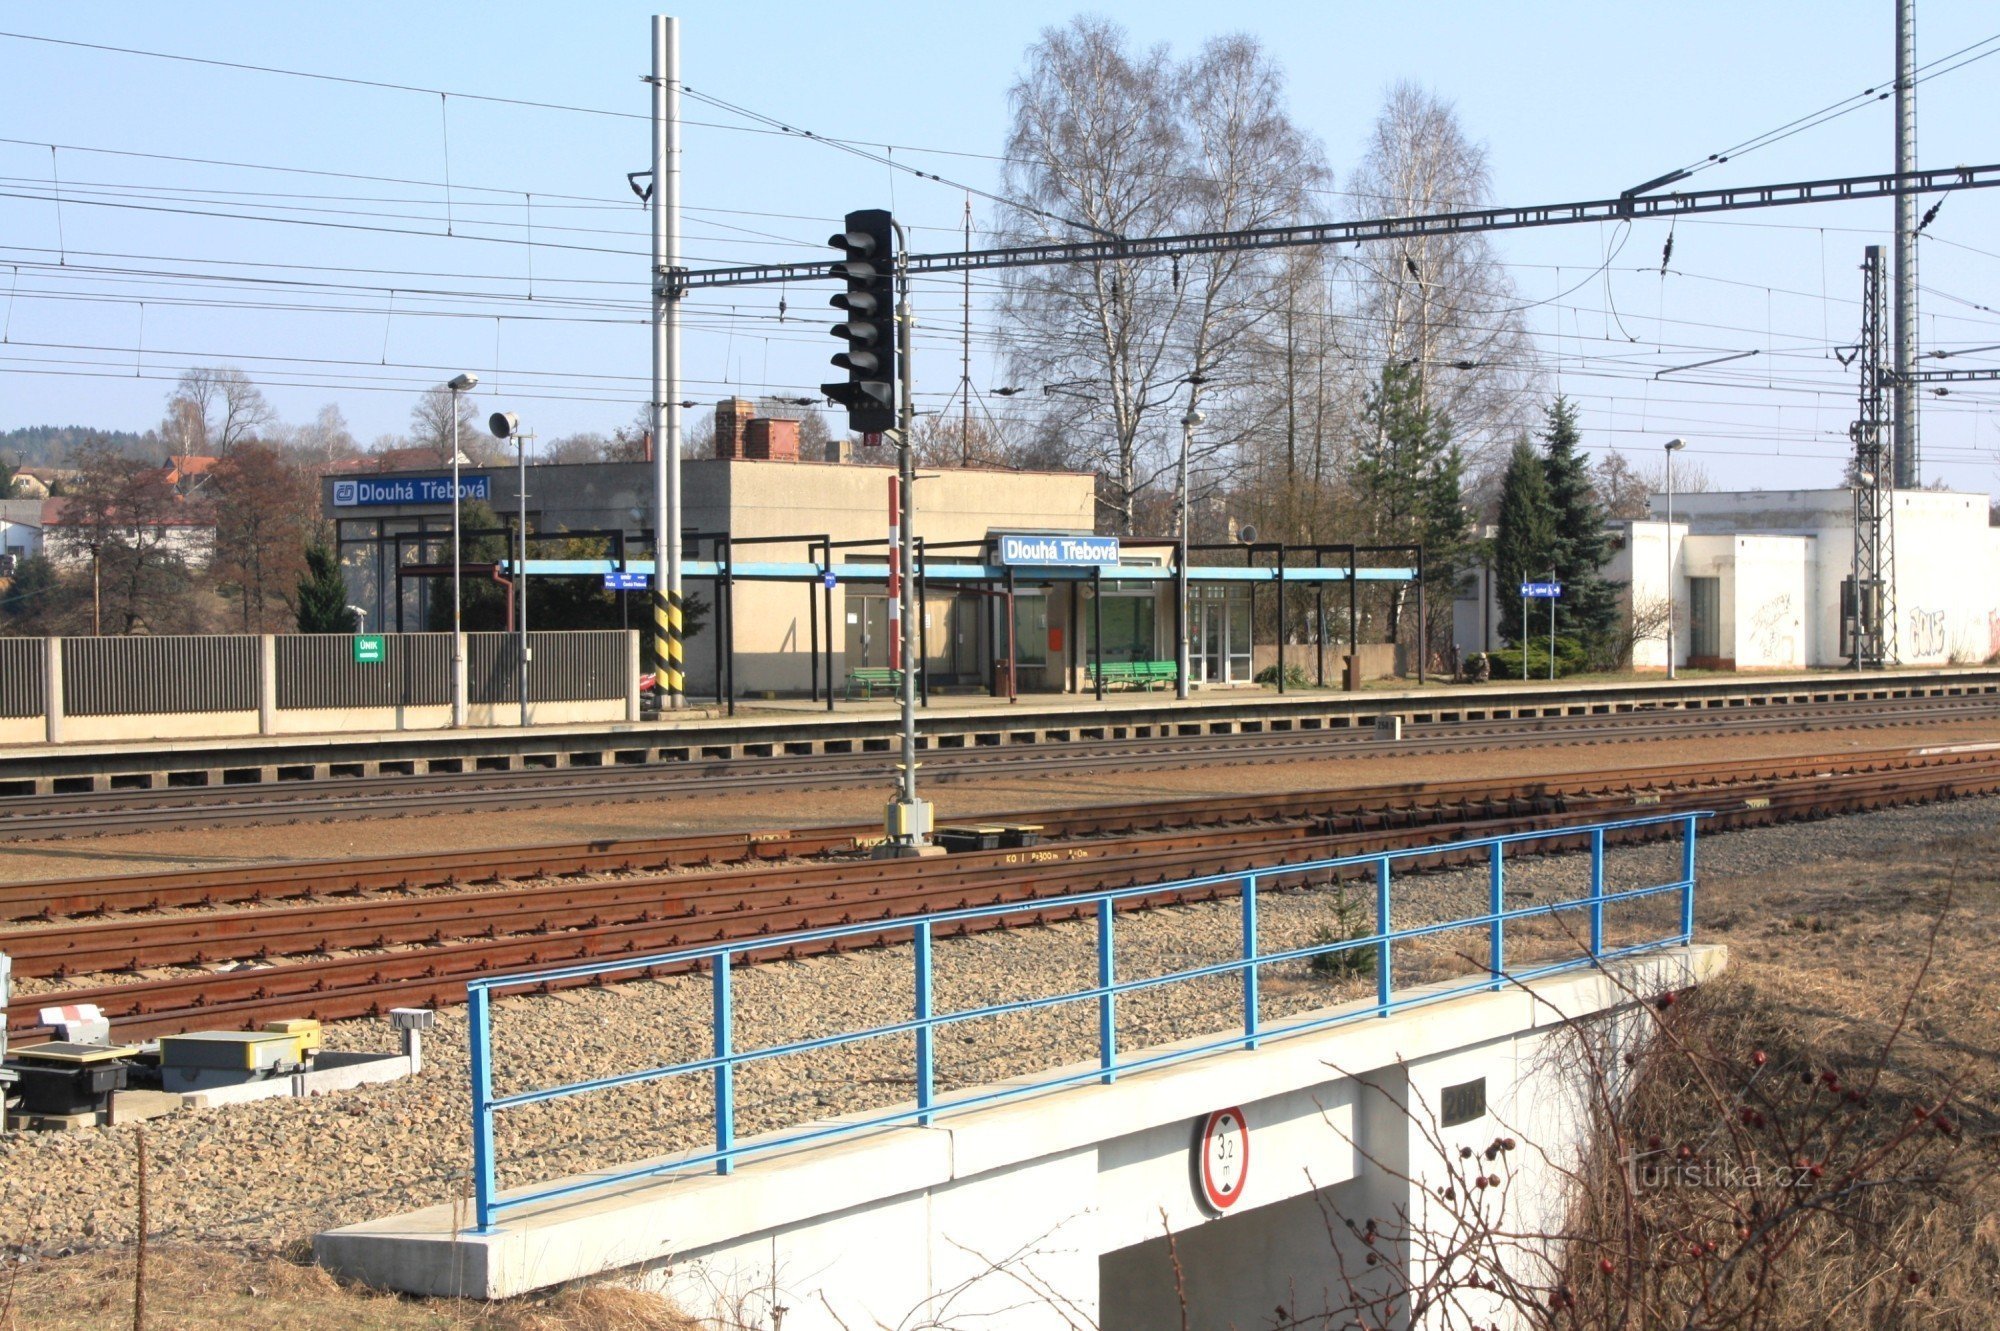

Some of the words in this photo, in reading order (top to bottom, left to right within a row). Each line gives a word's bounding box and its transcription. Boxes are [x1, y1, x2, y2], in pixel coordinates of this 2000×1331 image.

[360, 483, 412, 501] Dlouhá
[421, 479, 485, 500] Třebová
[1007, 540, 1057, 559] Dlouhá
[1061, 541, 1117, 561] Třebová
[360, 639, 378, 650] ÚNIK
[392, 1012, 405, 1028] VK
[1223, 1165, 1230, 1176] m
